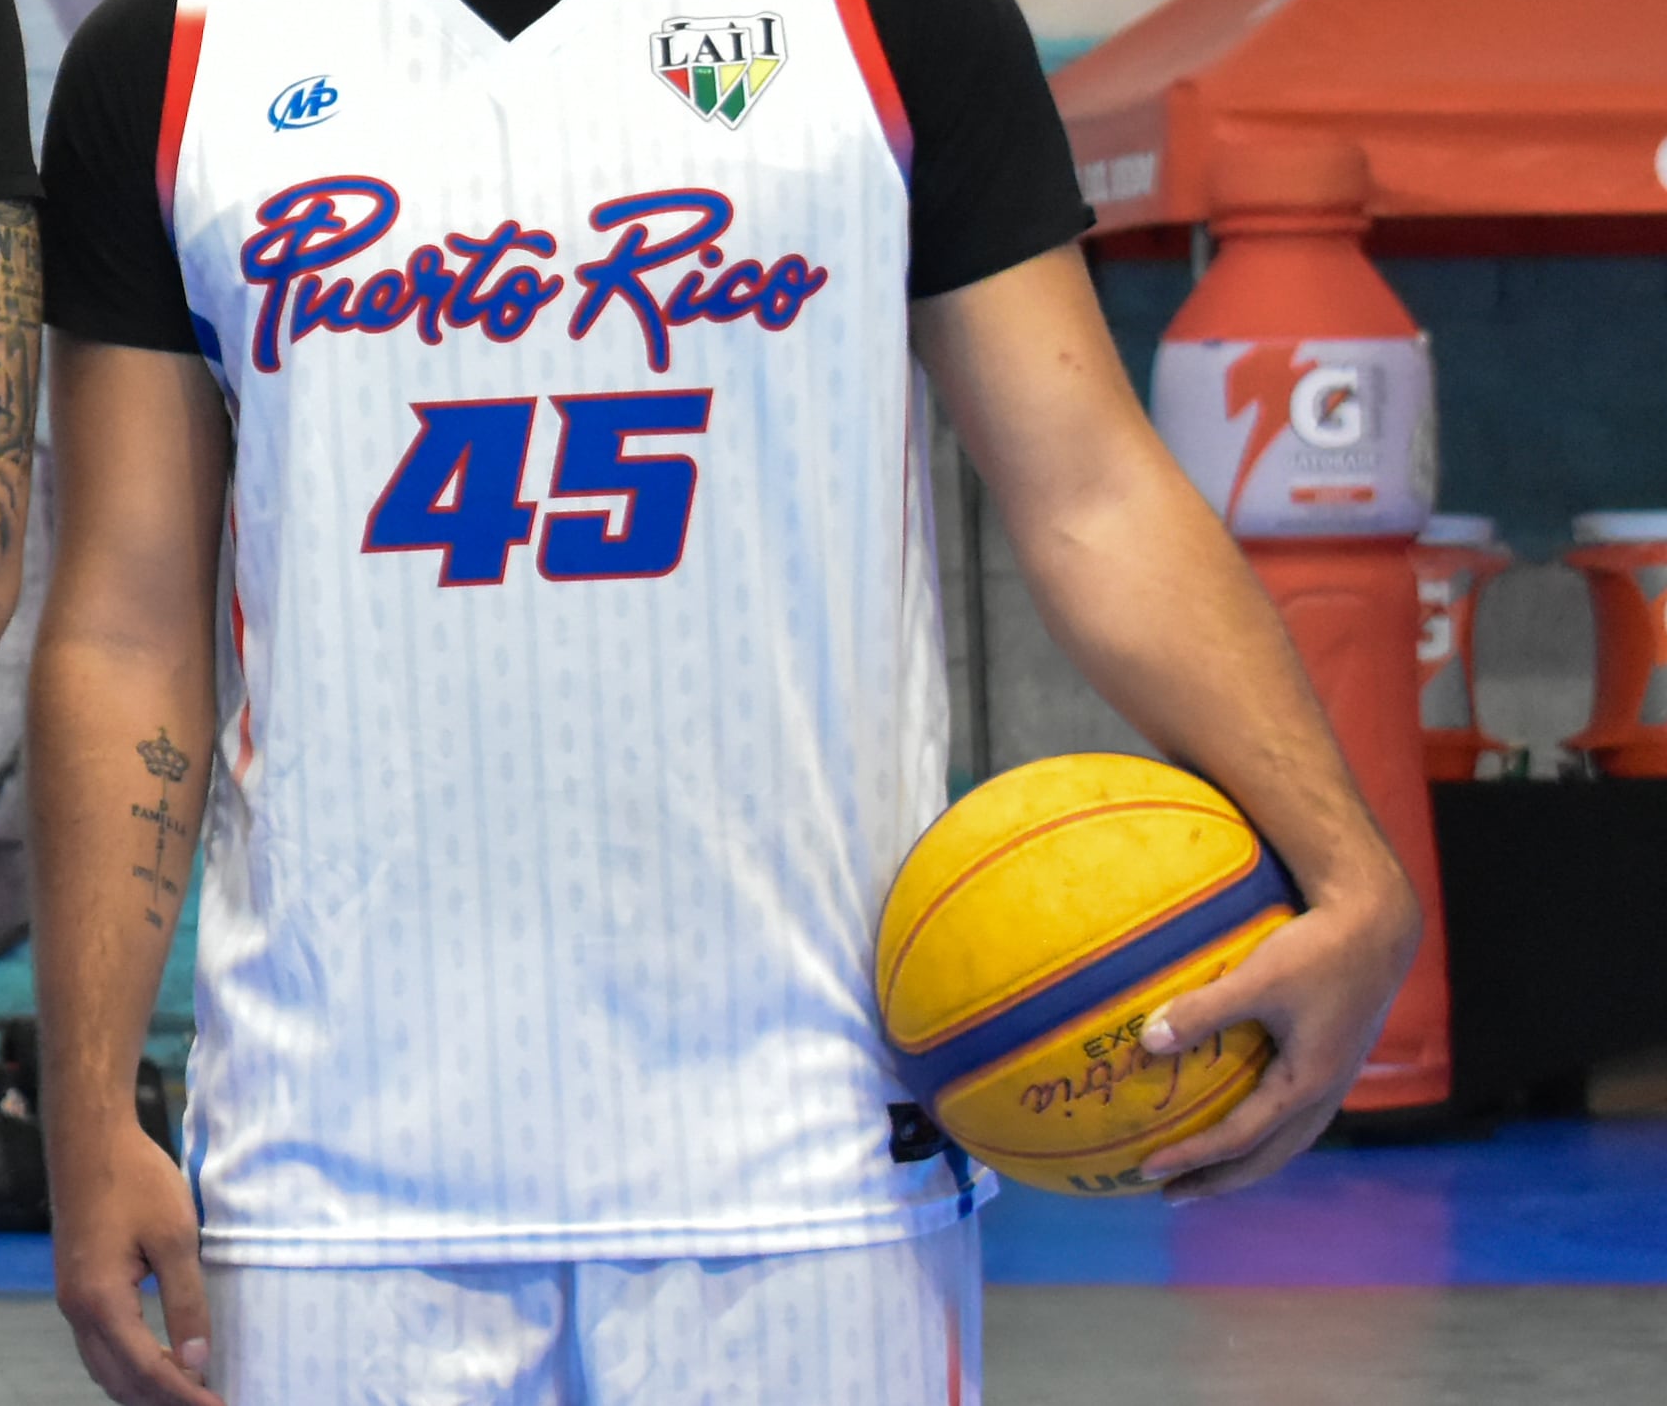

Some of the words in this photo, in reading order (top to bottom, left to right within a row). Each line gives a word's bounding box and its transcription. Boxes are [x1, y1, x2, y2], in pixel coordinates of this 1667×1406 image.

[657, 32, 747, 68] LAI
[240, 174, 564, 374] Puerto
[567, 187, 828, 374] Rico
[1290, 366, 1362, 449] G
[360, 388, 715, 588] 45
